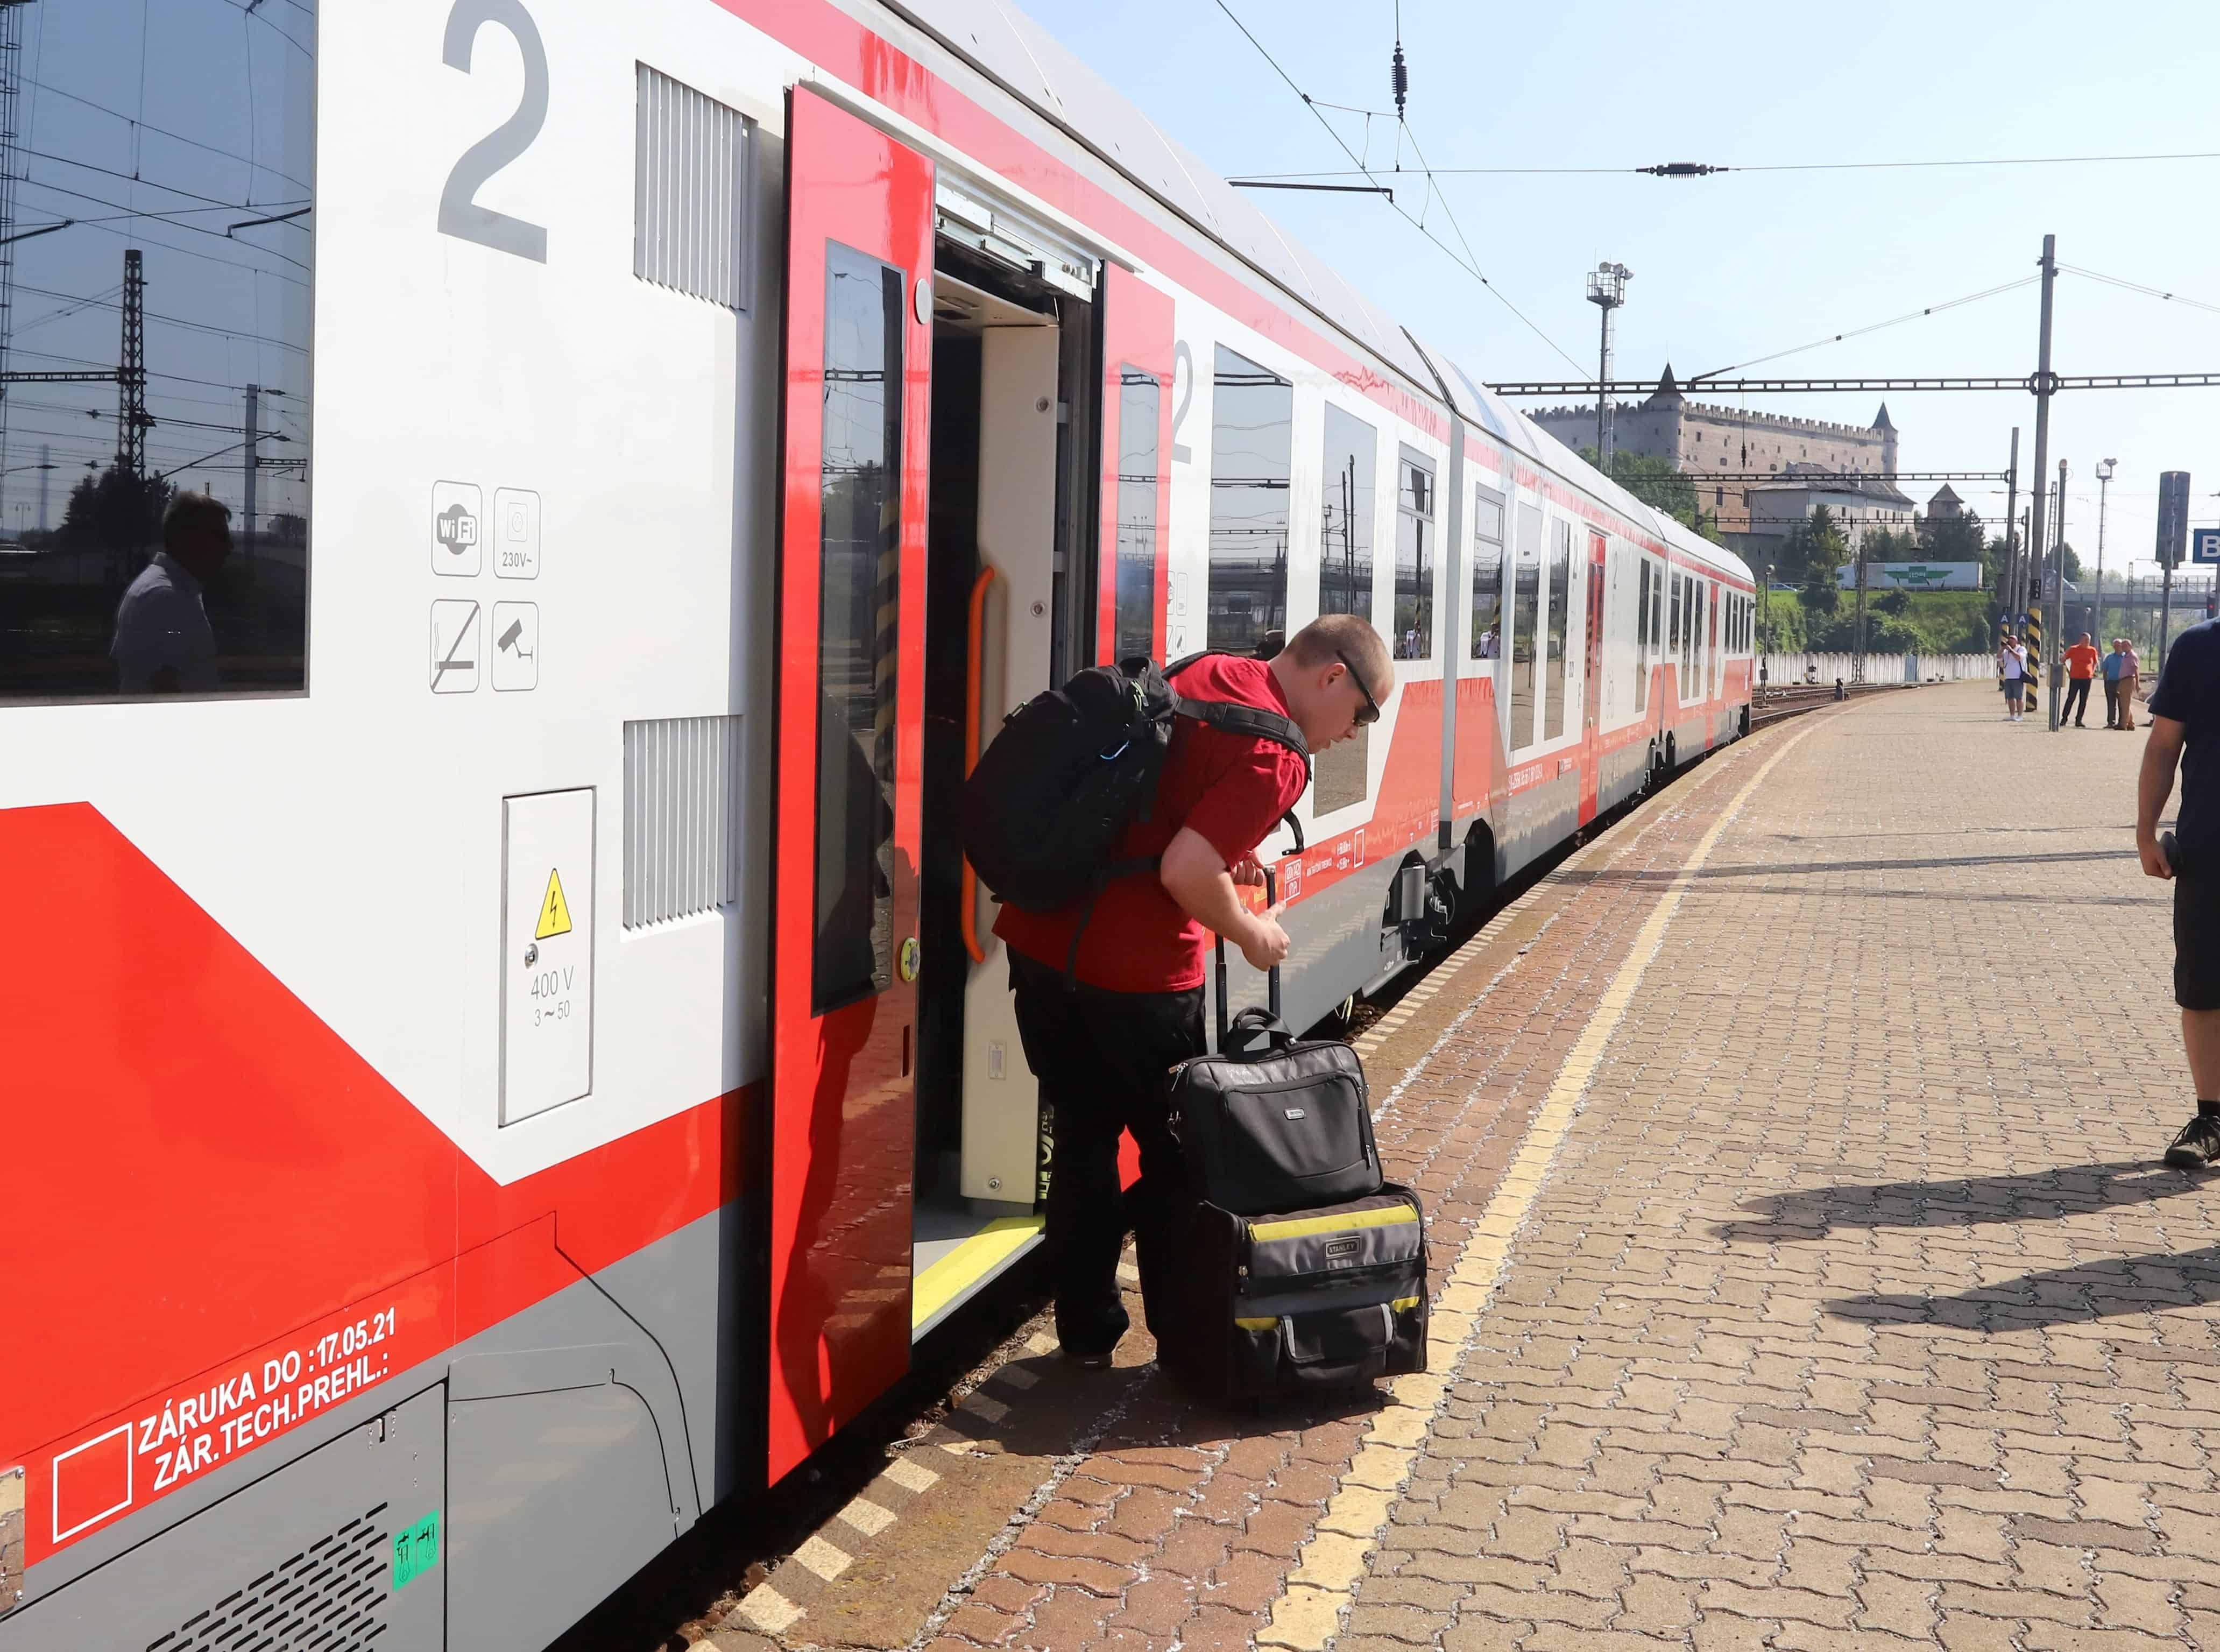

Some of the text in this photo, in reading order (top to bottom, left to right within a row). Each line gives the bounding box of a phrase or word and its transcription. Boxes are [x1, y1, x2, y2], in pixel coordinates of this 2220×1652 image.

[437, 0, 549, 264] 2
[1171, 340, 1193, 465] 2
[439, 518, 473, 540] WiFi
[2202, 535, 2220, 557] B
[2000, 615, 2009, 623] A
[2018, 615, 2026, 623] A
[531, 965, 574, 1000] 400 V
[1329, 1242, 1355, 1253] STANLEY
[138, 1372, 256, 1455] ZÁRUKA
[264, 1350, 301, 1394] DO
